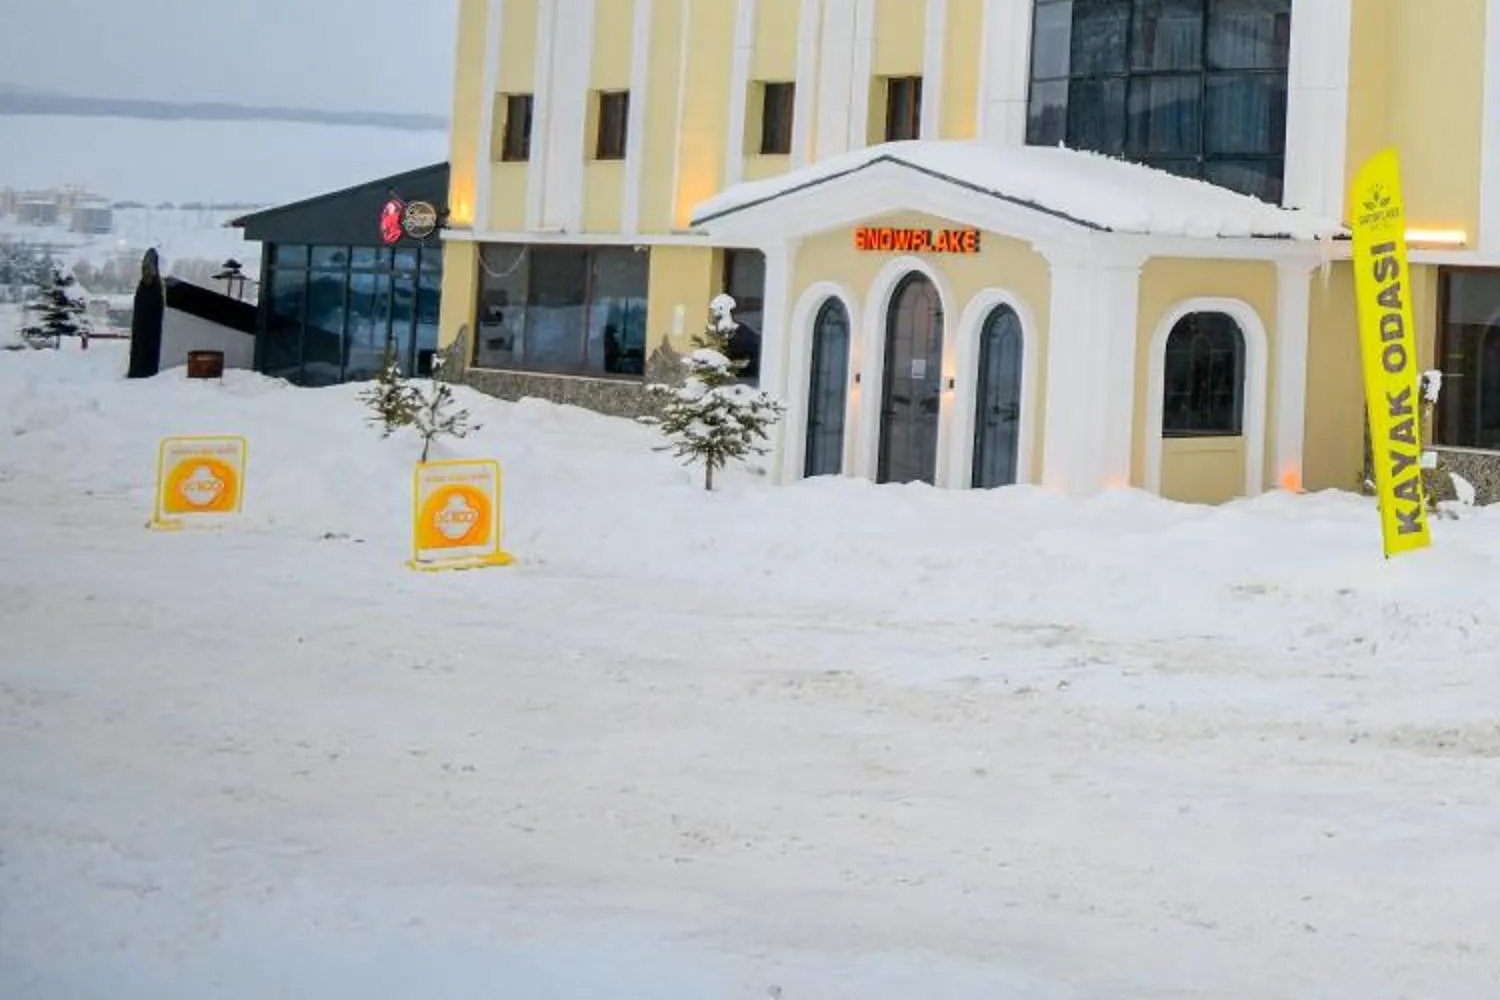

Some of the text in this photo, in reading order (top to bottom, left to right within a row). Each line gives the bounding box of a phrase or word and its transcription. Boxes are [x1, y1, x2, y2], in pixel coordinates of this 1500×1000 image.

[854, 226, 980, 253] SNOWFLAKE
[1370, 241, 1407, 373] ODASI
[1386, 385, 1424, 535] KAYAK
